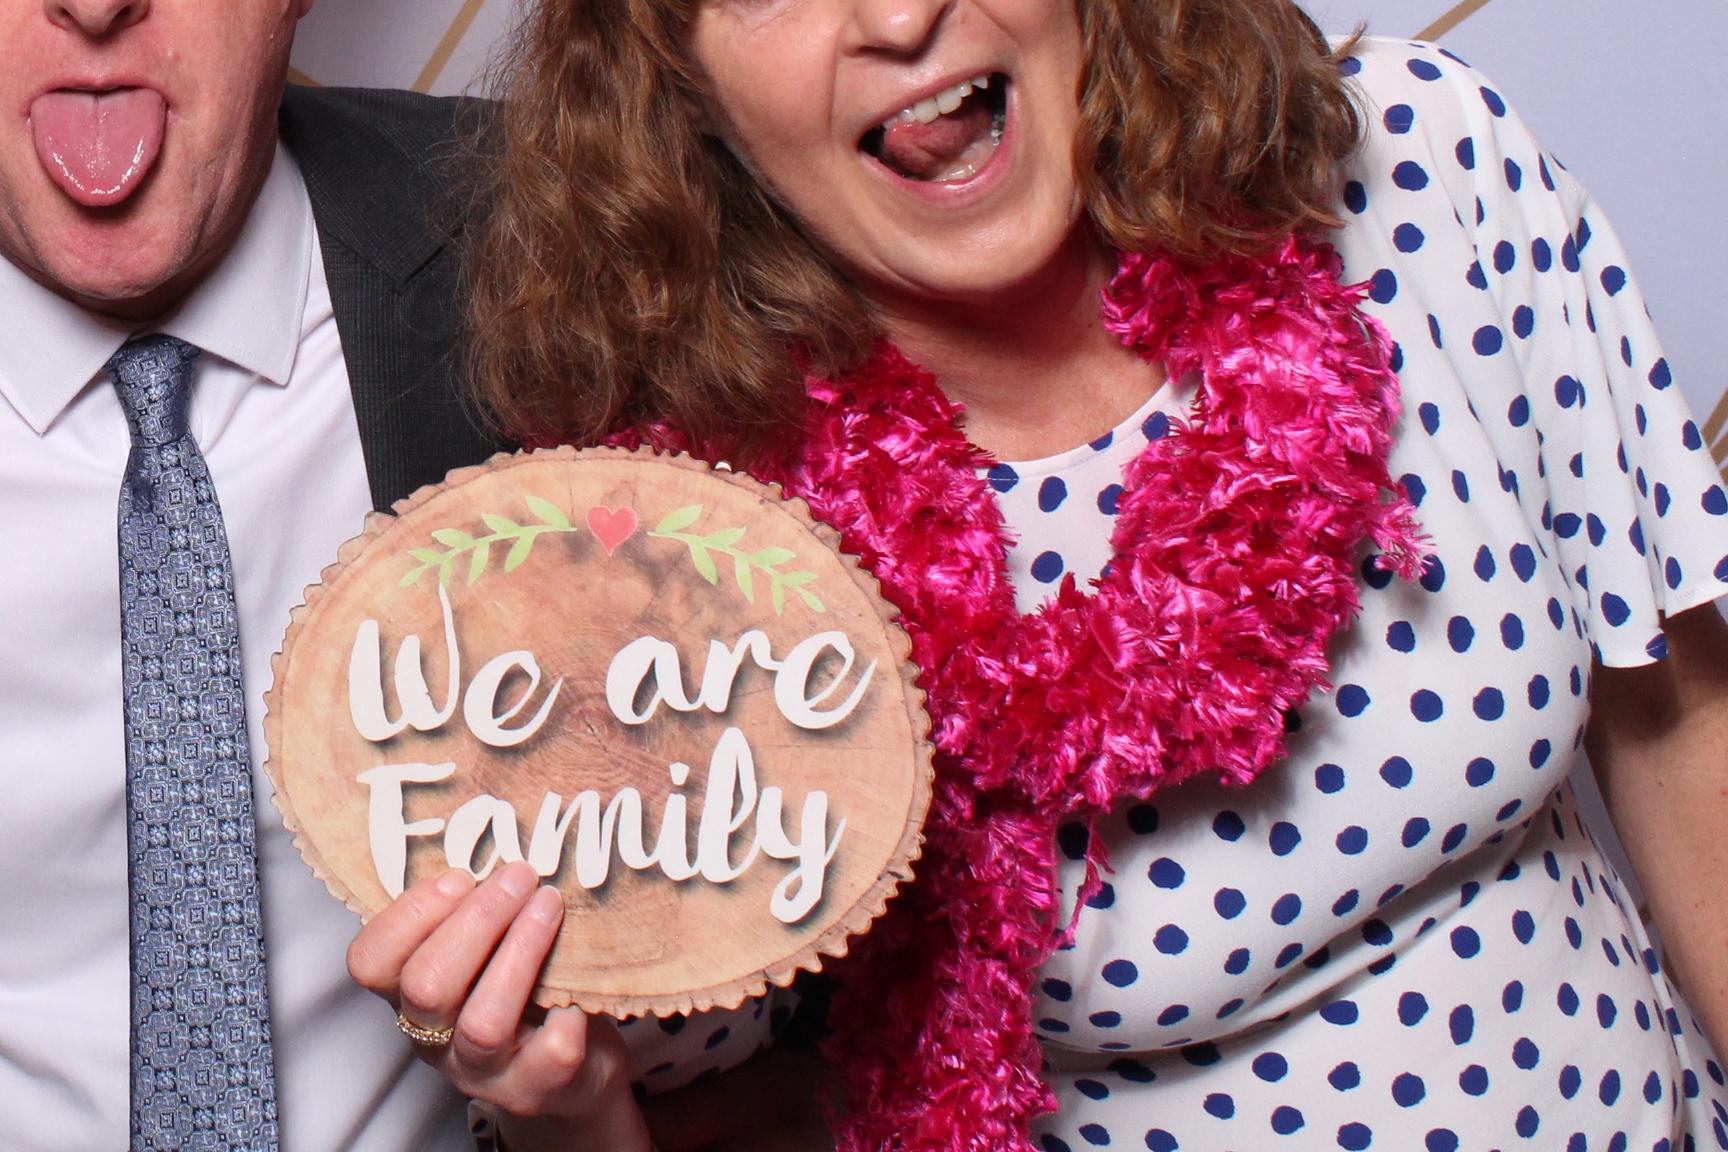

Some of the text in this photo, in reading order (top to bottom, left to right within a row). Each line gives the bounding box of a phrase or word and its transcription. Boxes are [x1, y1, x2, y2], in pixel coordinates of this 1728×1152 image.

[349, 583, 877, 747] We are
[356, 727, 847, 924] Family
